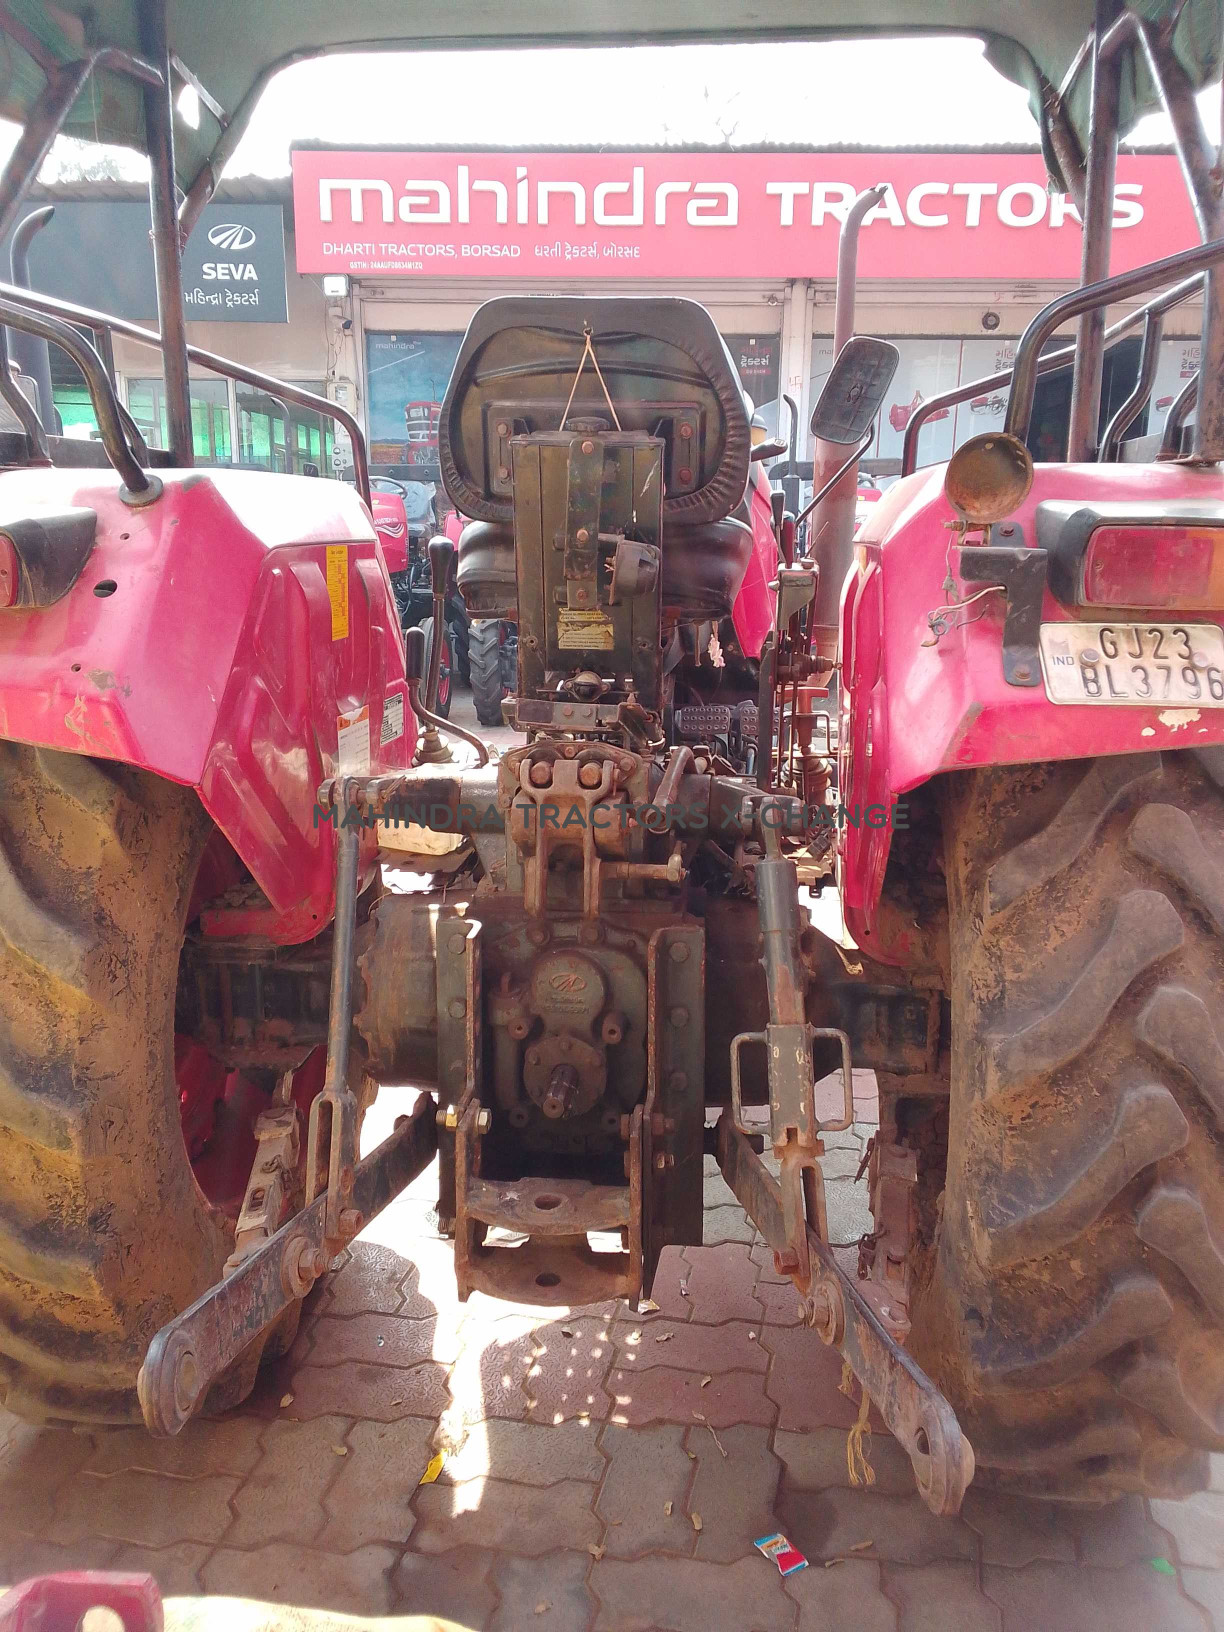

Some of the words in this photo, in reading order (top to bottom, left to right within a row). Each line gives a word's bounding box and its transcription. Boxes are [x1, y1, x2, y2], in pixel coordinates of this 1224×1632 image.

[318, 165, 738, 227] mahindra
[322, 242, 375, 255] DHARTI
[379, 243, 458, 259] TRACTORS,
[461, 244, 521, 257] BORSAD
[534, 241, 562, 257] ધરતી
[603, 242, 641, 258] બોરસદ
[202, 263, 259, 280] SEVA
[1099, 627, 1192, 660] GJ23
[1052, 655, 1075, 666] IND
[1080, 664, 1224, 700] BL3796
